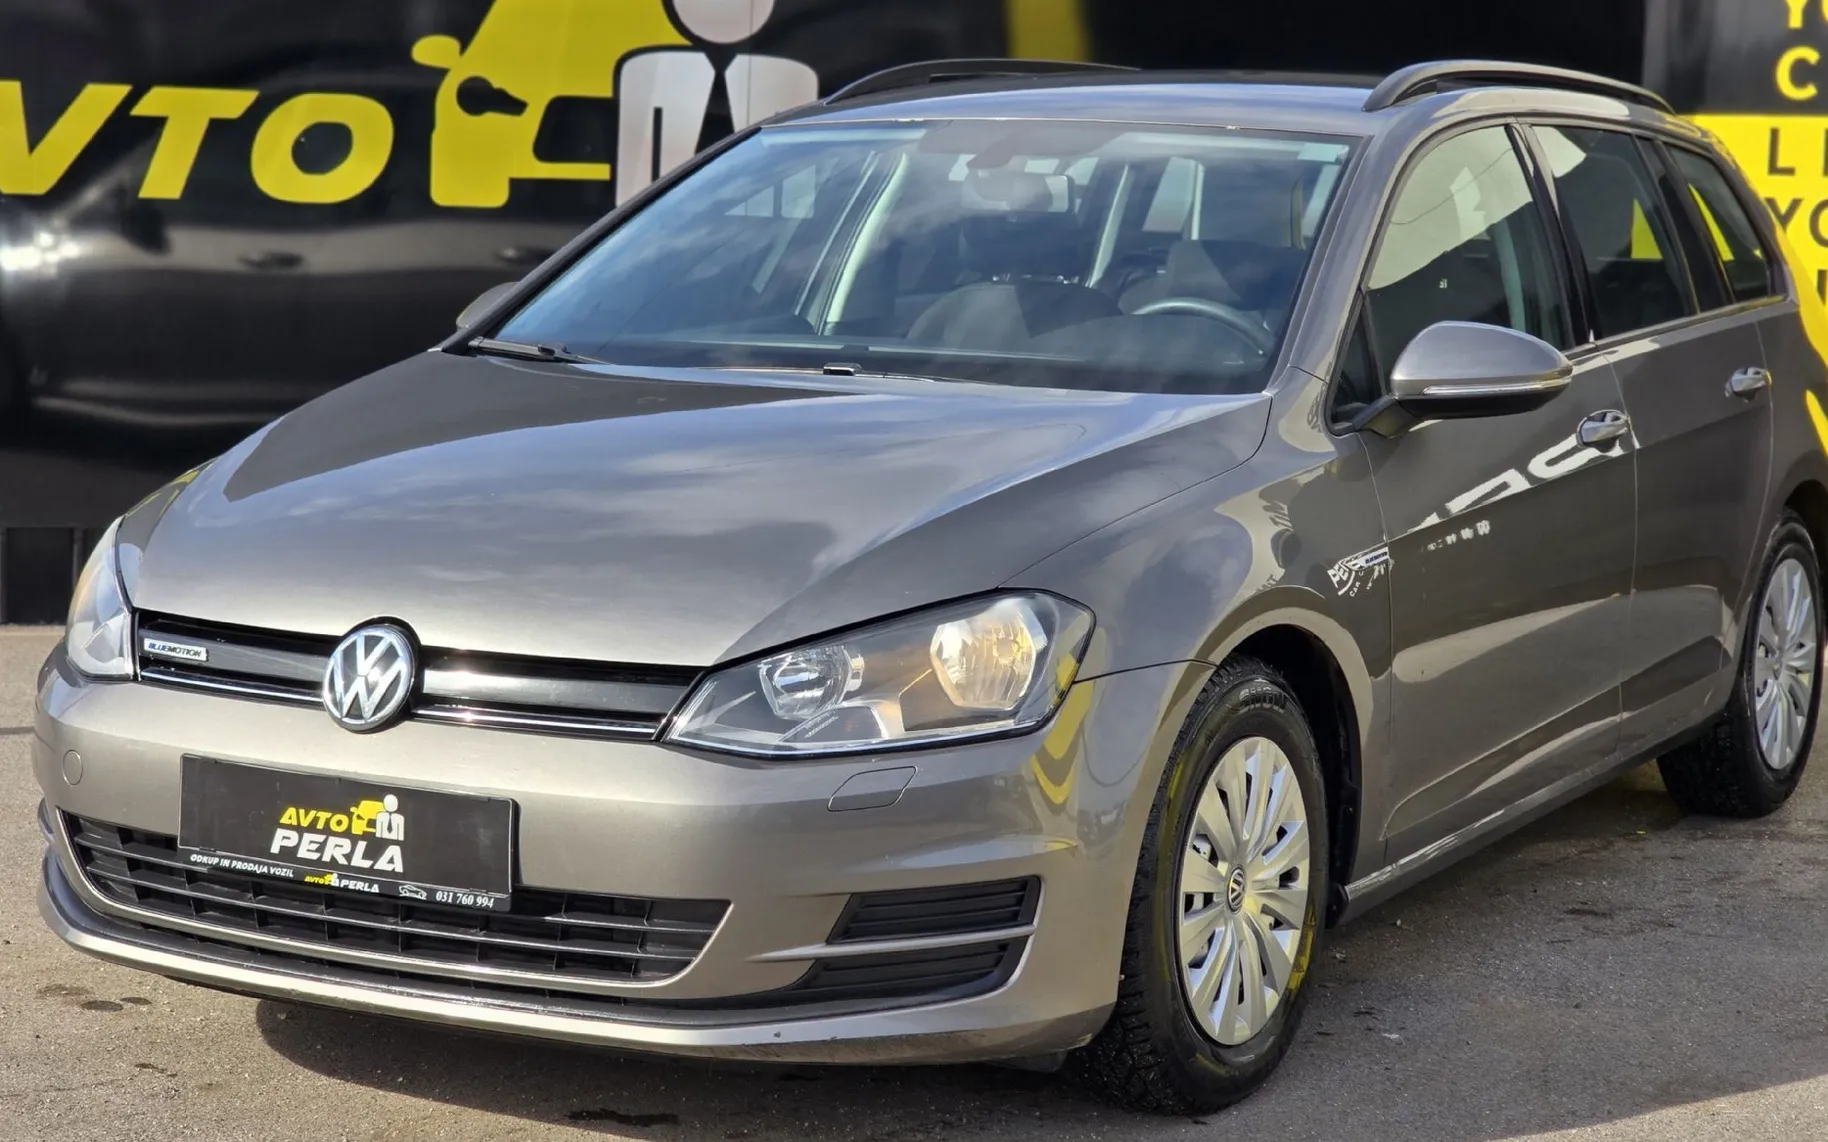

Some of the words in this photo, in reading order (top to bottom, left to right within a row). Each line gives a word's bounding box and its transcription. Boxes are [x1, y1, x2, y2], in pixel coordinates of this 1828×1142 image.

[147, 642, 202, 657] BLUEMOTION
[279, 806, 349, 833] AVTO
[270, 827, 404, 873] PERLA
[190, 853, 219, 866] ODKUP
[220, 859, 230, 868] IN
[231, 860, 268, 874] PRODAJA
[270, 867, 294, 878] VOZIL
[304, 876, 324, 885] AVTO
[340, 880, 380, 893] PERLA
[435, 890, 453, 903] 031
[457, 893, 474, 905] 760
[476, 896, 494, 909] 994
